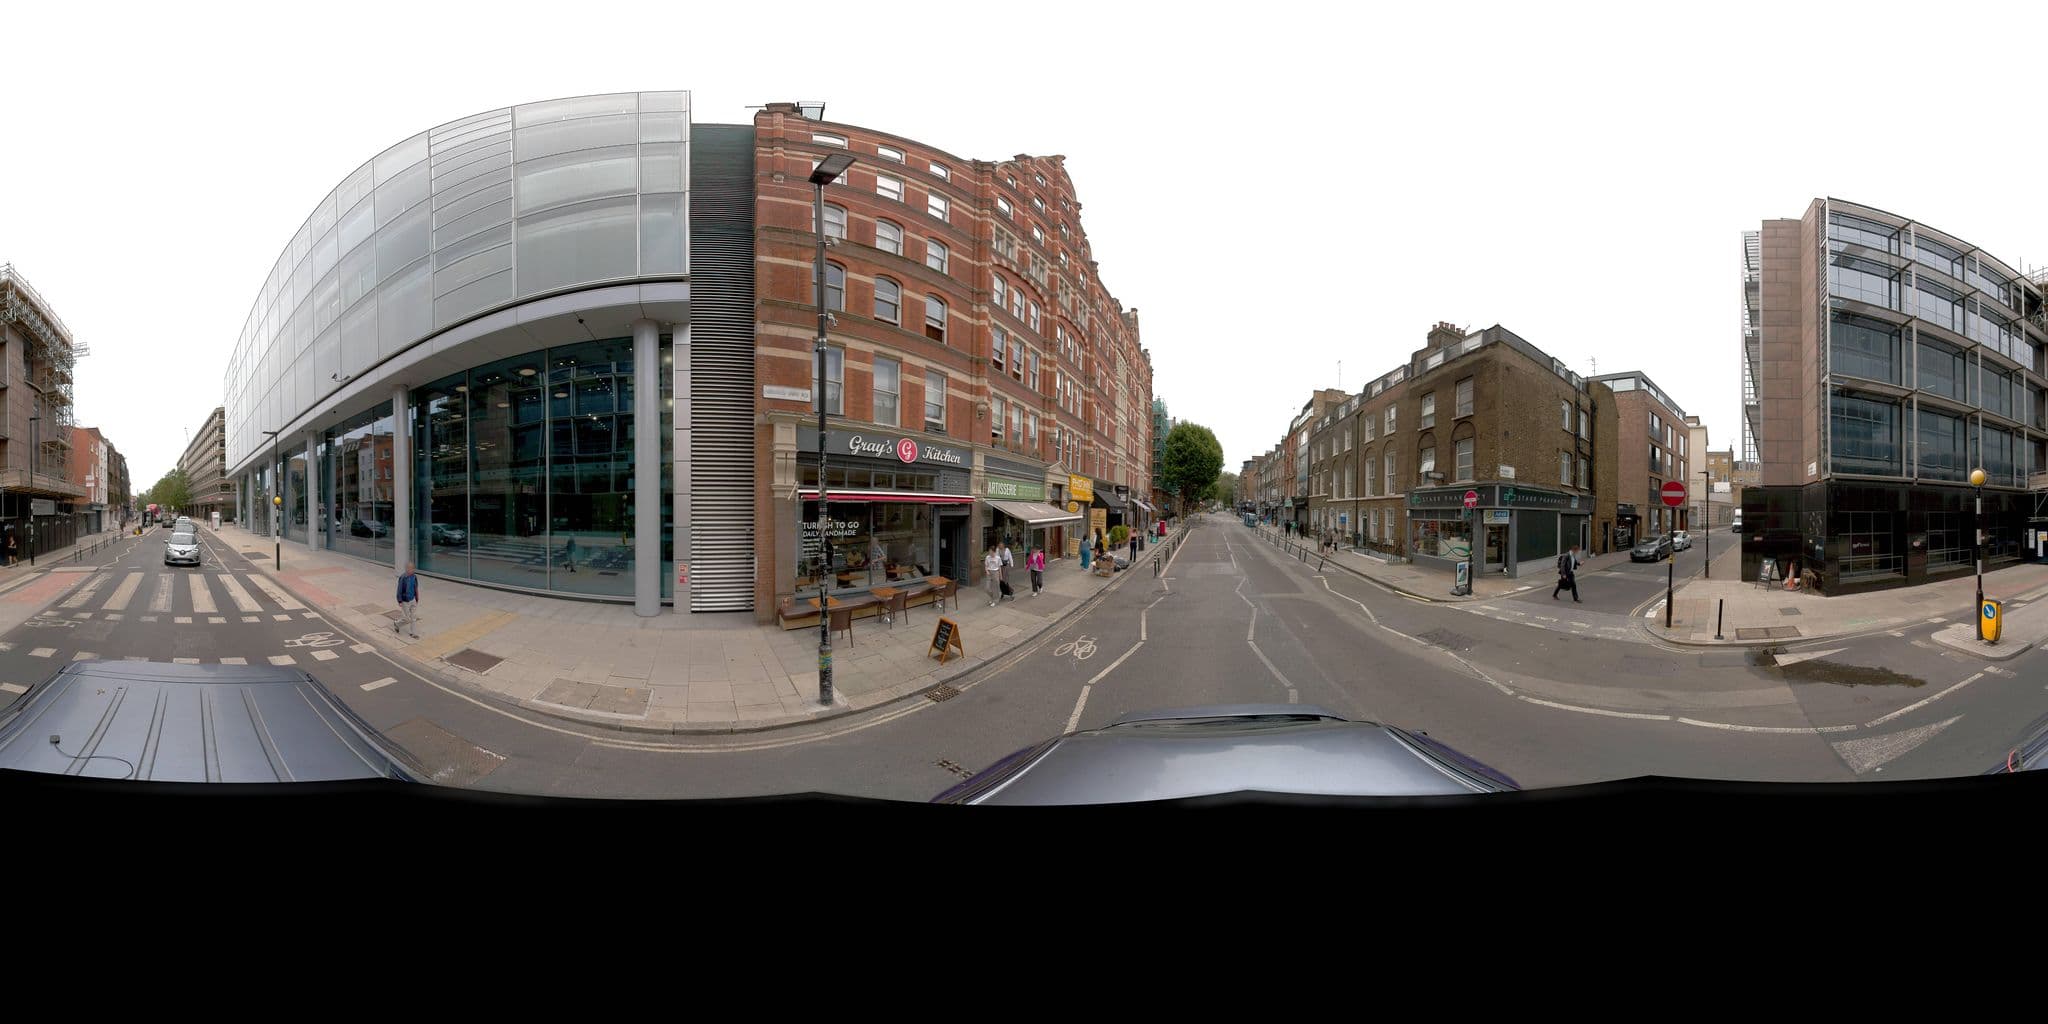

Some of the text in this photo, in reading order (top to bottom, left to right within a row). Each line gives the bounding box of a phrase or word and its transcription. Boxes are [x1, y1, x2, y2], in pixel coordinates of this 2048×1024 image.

[849, 435, 960, 464] Gray's G Kitchen
[988, 482, 1017, 496] ARTISSERIE
[836, 521, 846, 529] TO
[847, 521, 860, 529] GO
[823, 529, 857, 537] ANDMADE
